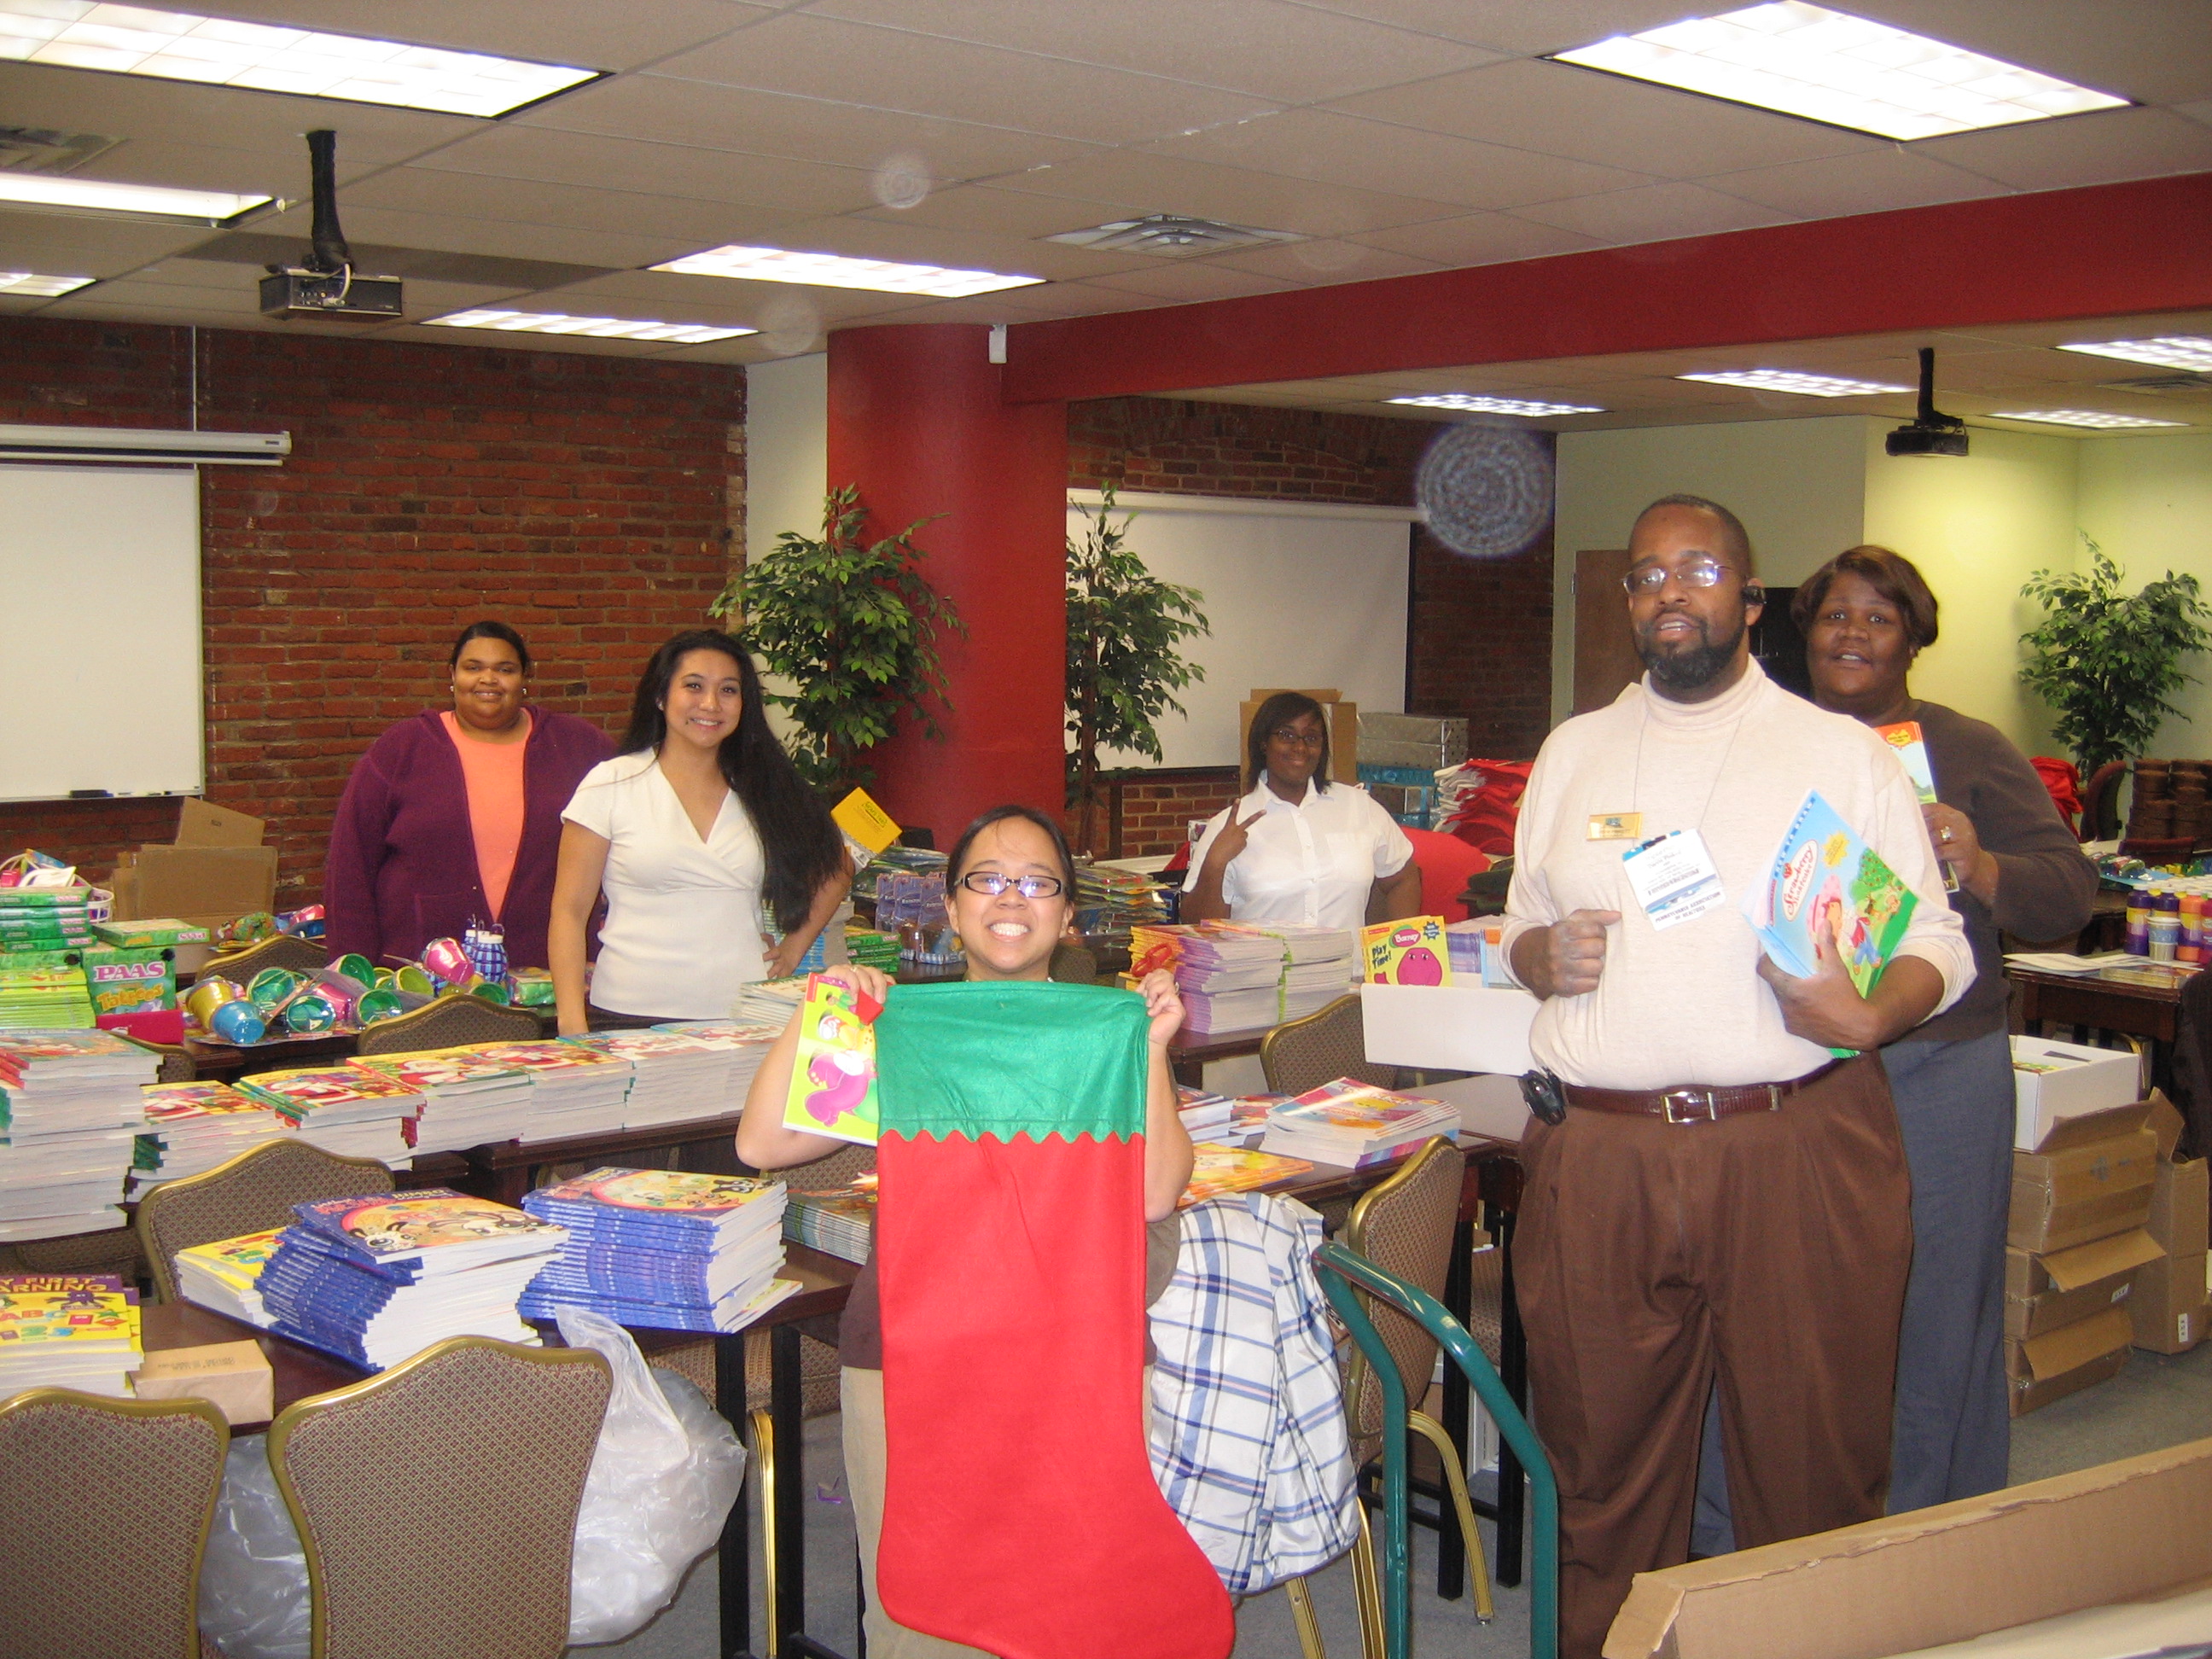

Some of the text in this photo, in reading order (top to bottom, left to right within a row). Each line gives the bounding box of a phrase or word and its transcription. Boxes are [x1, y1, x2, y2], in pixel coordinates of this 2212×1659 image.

[1784, 845, 1814, 916] Strawberry
[1394, 932, 1419, 943] Barney
[1371, 943, 1388, 958] Play
[1372, 951, 1393, 969] Time!
[94, 962, 165, 981] PAAS
